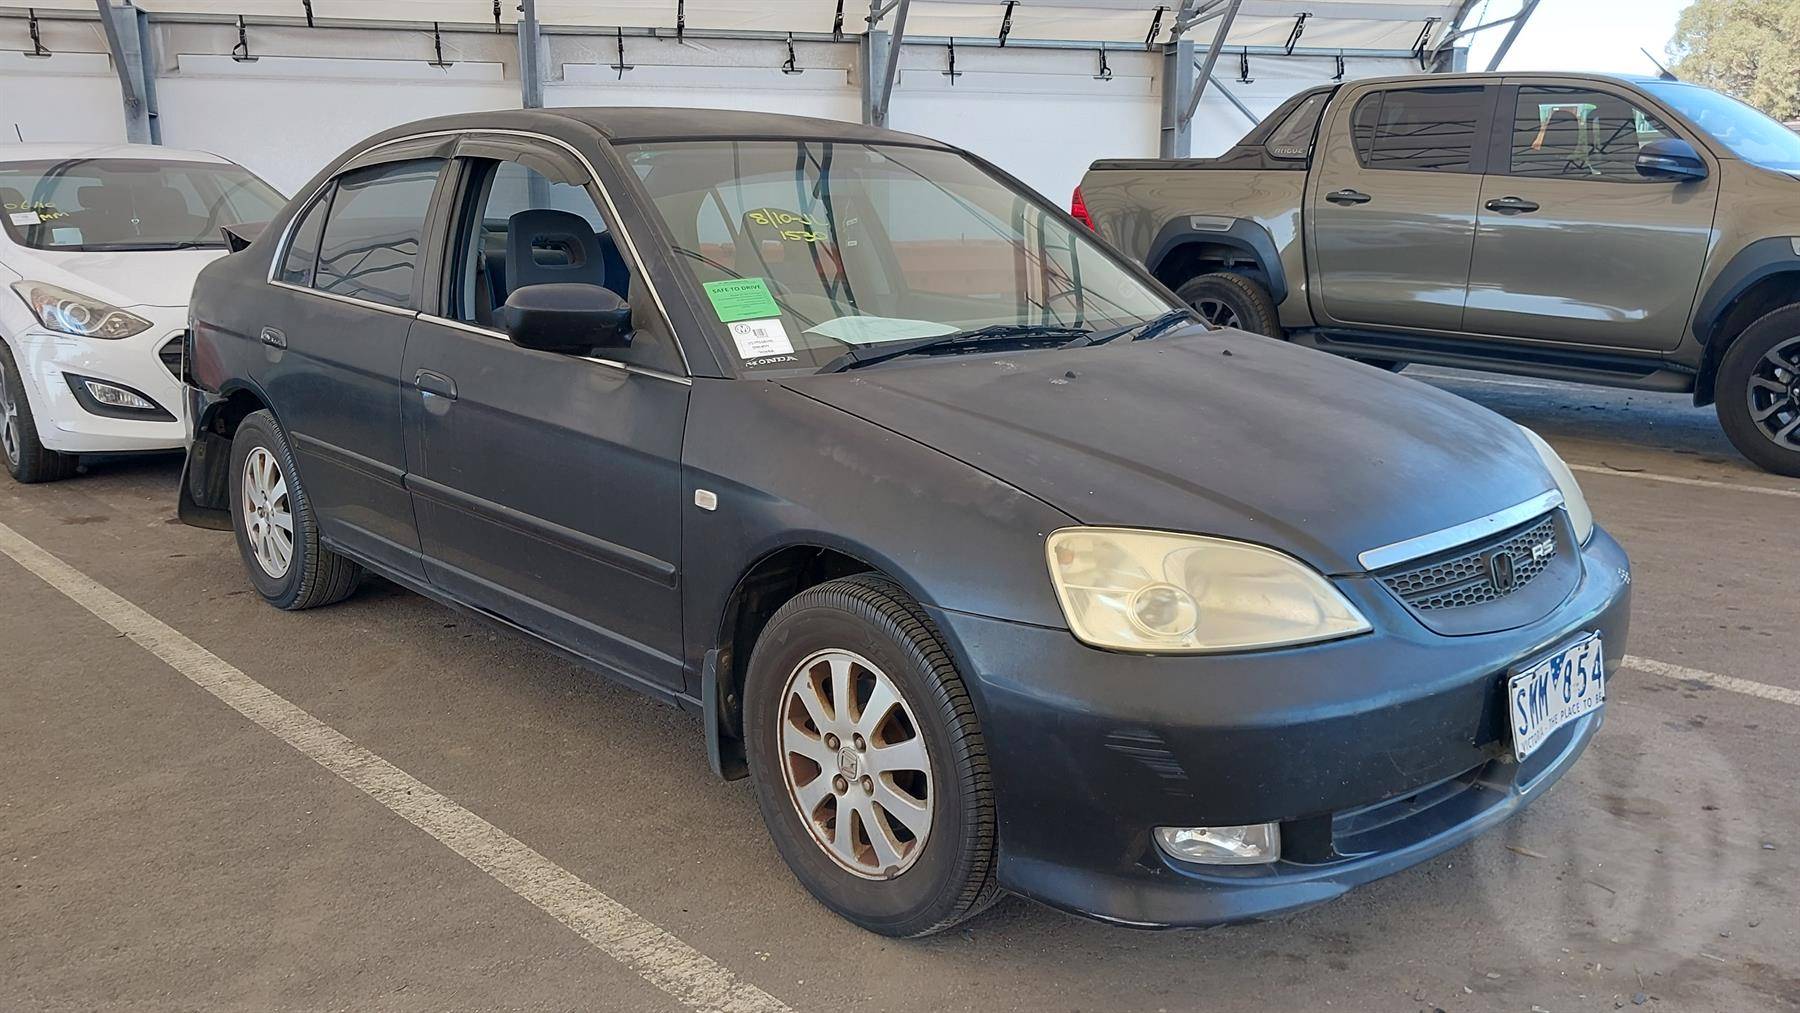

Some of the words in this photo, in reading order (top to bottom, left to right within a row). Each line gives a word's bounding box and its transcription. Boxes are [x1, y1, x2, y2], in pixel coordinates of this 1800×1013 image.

[712, 286, 731, 294] SAFE
[742, 284, 761, 292] DRIVE
[1563, 646, 1601, 703] 854
